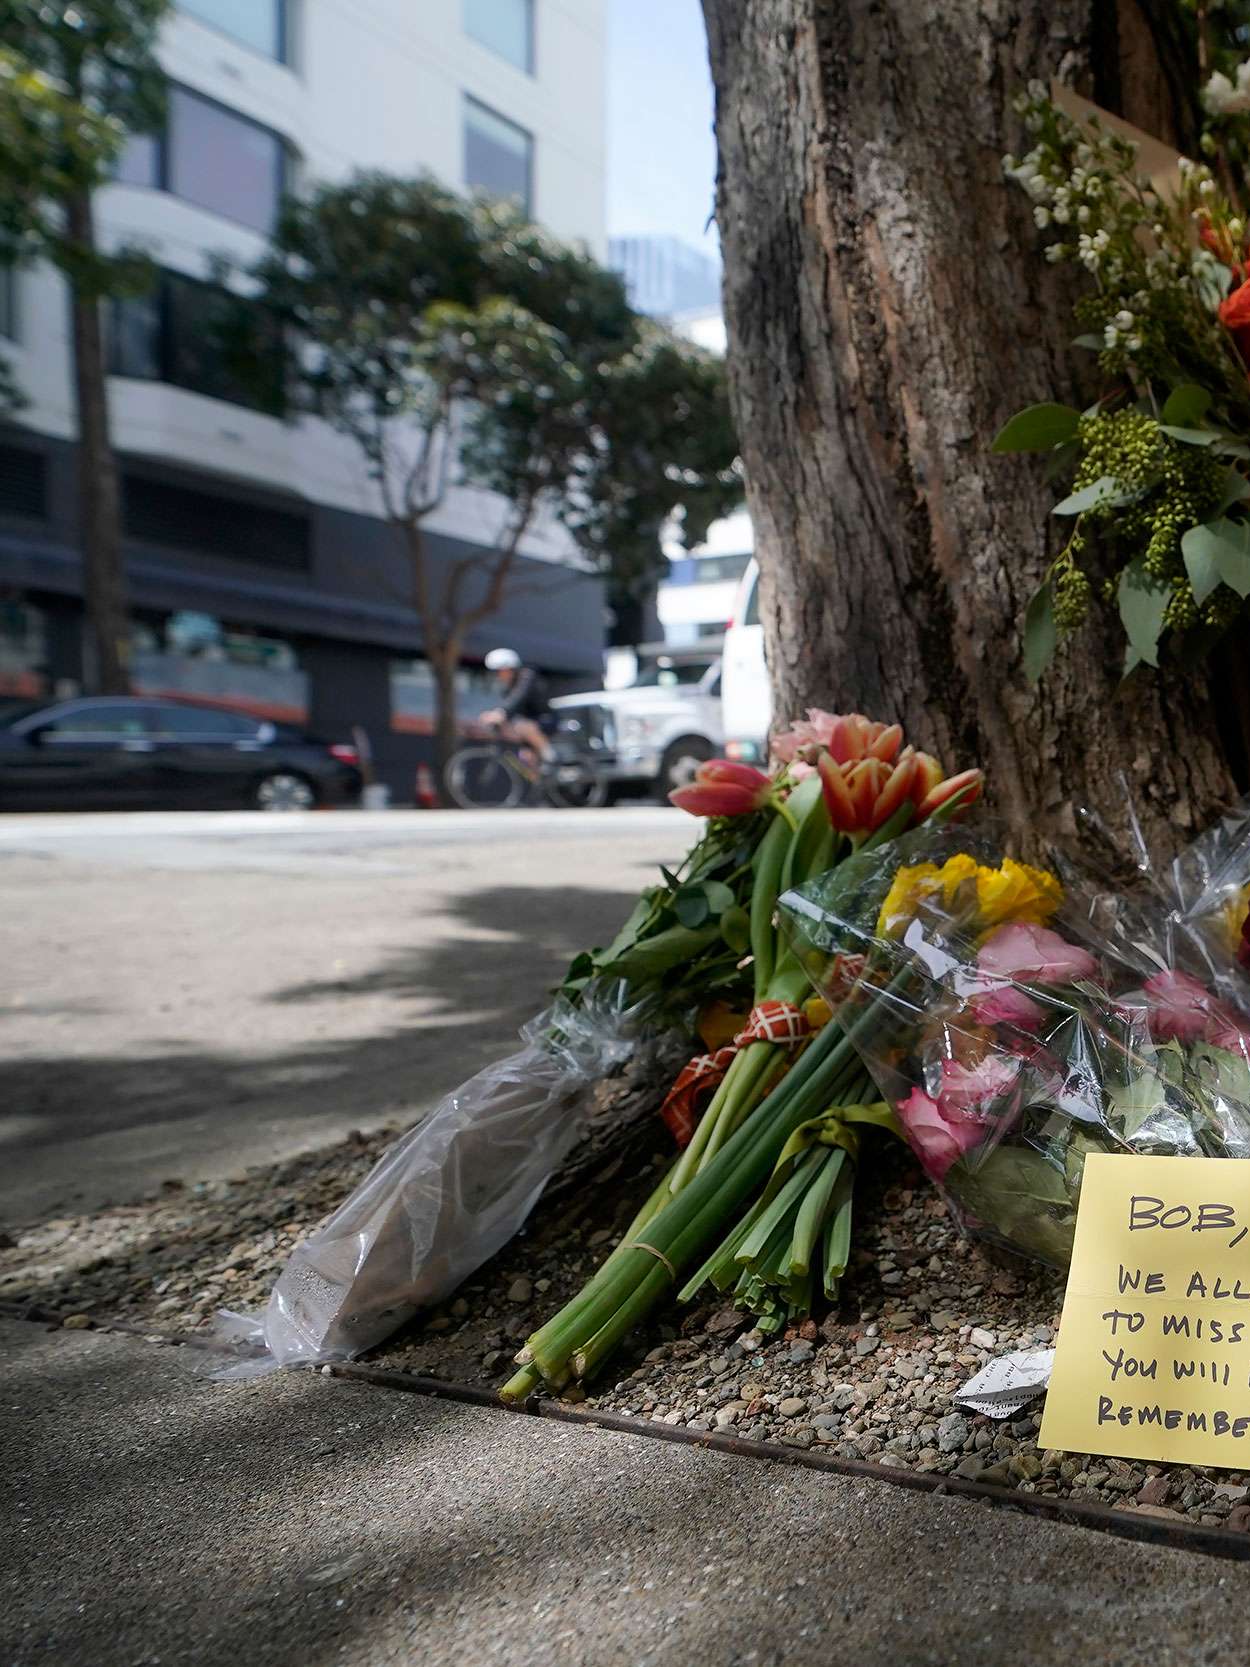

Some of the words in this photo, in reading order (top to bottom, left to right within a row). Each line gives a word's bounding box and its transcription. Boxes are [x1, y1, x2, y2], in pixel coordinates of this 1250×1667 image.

[1128, 1195, 1249, 1249] BOB,
[1118, 1264, 1166, 1295] WE
[1102, 1308, 1145, 1335] TO
[1162, 1314, 1245, 1344] MISS
[1102, 1348, 1158, 1382] YOU
